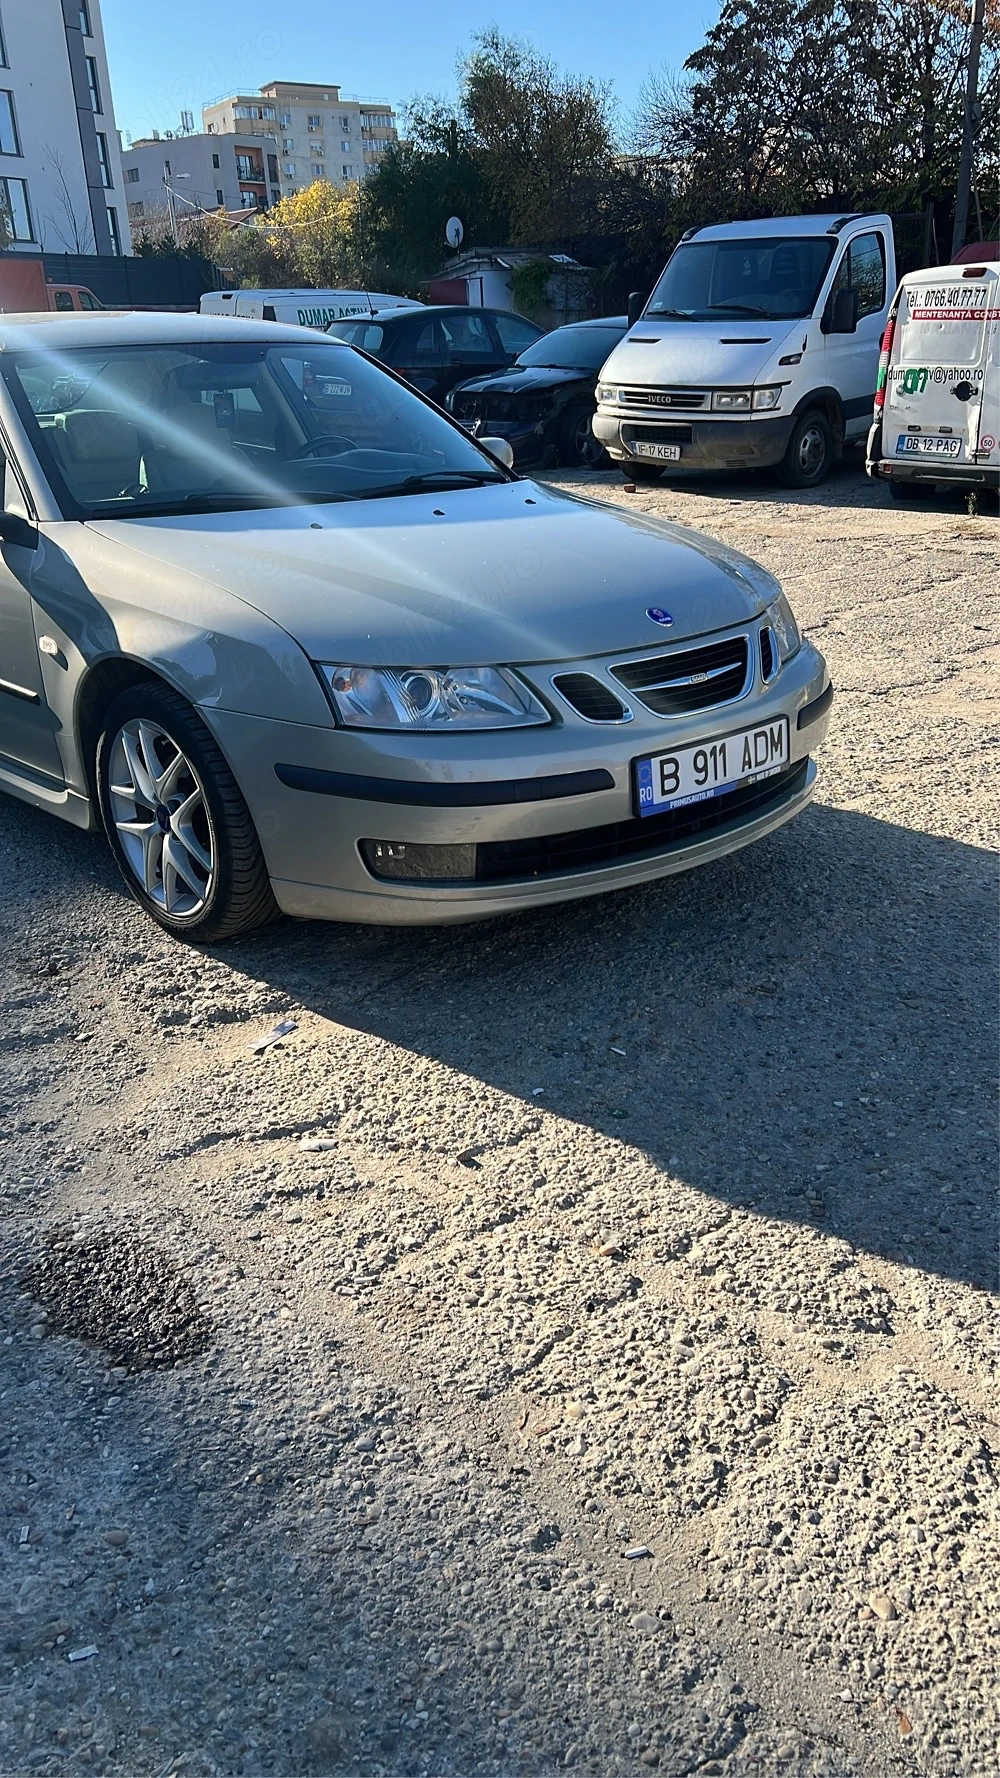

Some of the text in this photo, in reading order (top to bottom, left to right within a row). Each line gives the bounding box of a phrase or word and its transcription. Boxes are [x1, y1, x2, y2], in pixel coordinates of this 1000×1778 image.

[924, 288, 987, 307] 0766.40.77.77
[297, 307, 368, 326] DUMAR ACT
[648, 394, 672, 404] IVECO
[648, 445, 656, 454] 17
[657, 446, 677, 458] KEH
[905, 437, 919, 450] DB
[923, 439, 933, 451] 12
[936, 440, 957, 452] PAG
[983, 439, 993, 447] 50
[659, 723, 783, 797] B 911 ADM
[639, 786, 653, 803] RO
[669, 789, 715, 809] PRIMUSAUTO.RO
